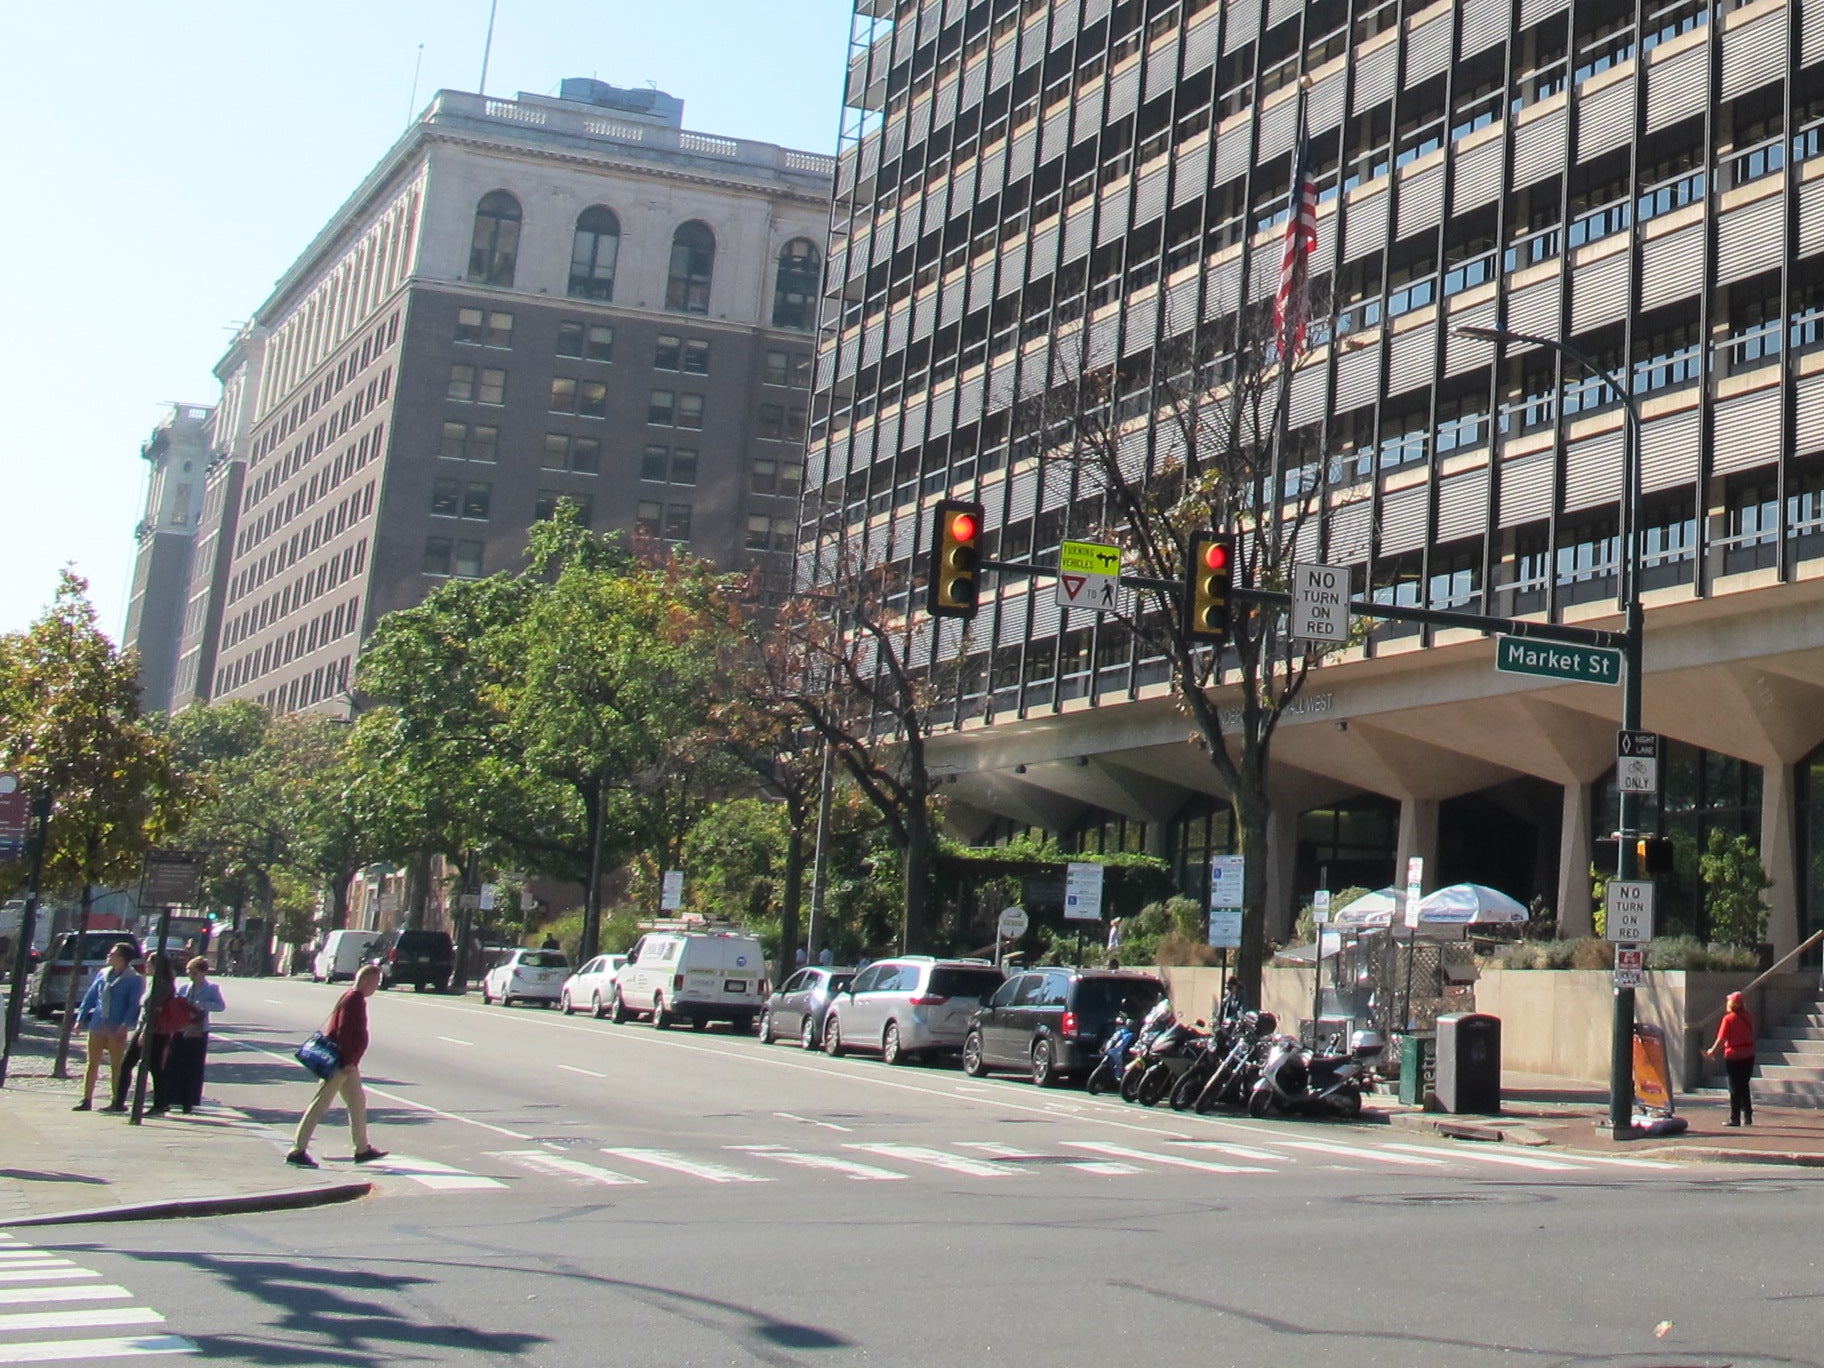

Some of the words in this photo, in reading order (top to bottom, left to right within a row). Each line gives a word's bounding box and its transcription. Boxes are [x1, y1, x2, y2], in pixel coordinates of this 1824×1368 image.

[1063, 544, 1094, 556] TURNING
[1063, 557, 1094, 569] VEHICLES
[1309, 571, 1335, 588] NO
[1087, 588, 1097, 599] TO
[1304, 589, 1339, 604] TURN
[1312, 606, 1330, 619] ON
[1307, 620, 1334, 634] RED
[1508, 644, 1580, 671] Market
[1588, 655, 1609, 675] St
[1307, 693, 1333, 712] WEST
[1635, 746, 1654, 755] LANE
[1625, 776, 1649, 789] ONLY
[1620, 886, 1640, 899] NO
[1616, 901, 1643, 912] TURN
[1622, 915, 1637, 925] ON
[1619, 927, 1640, 938] RED
